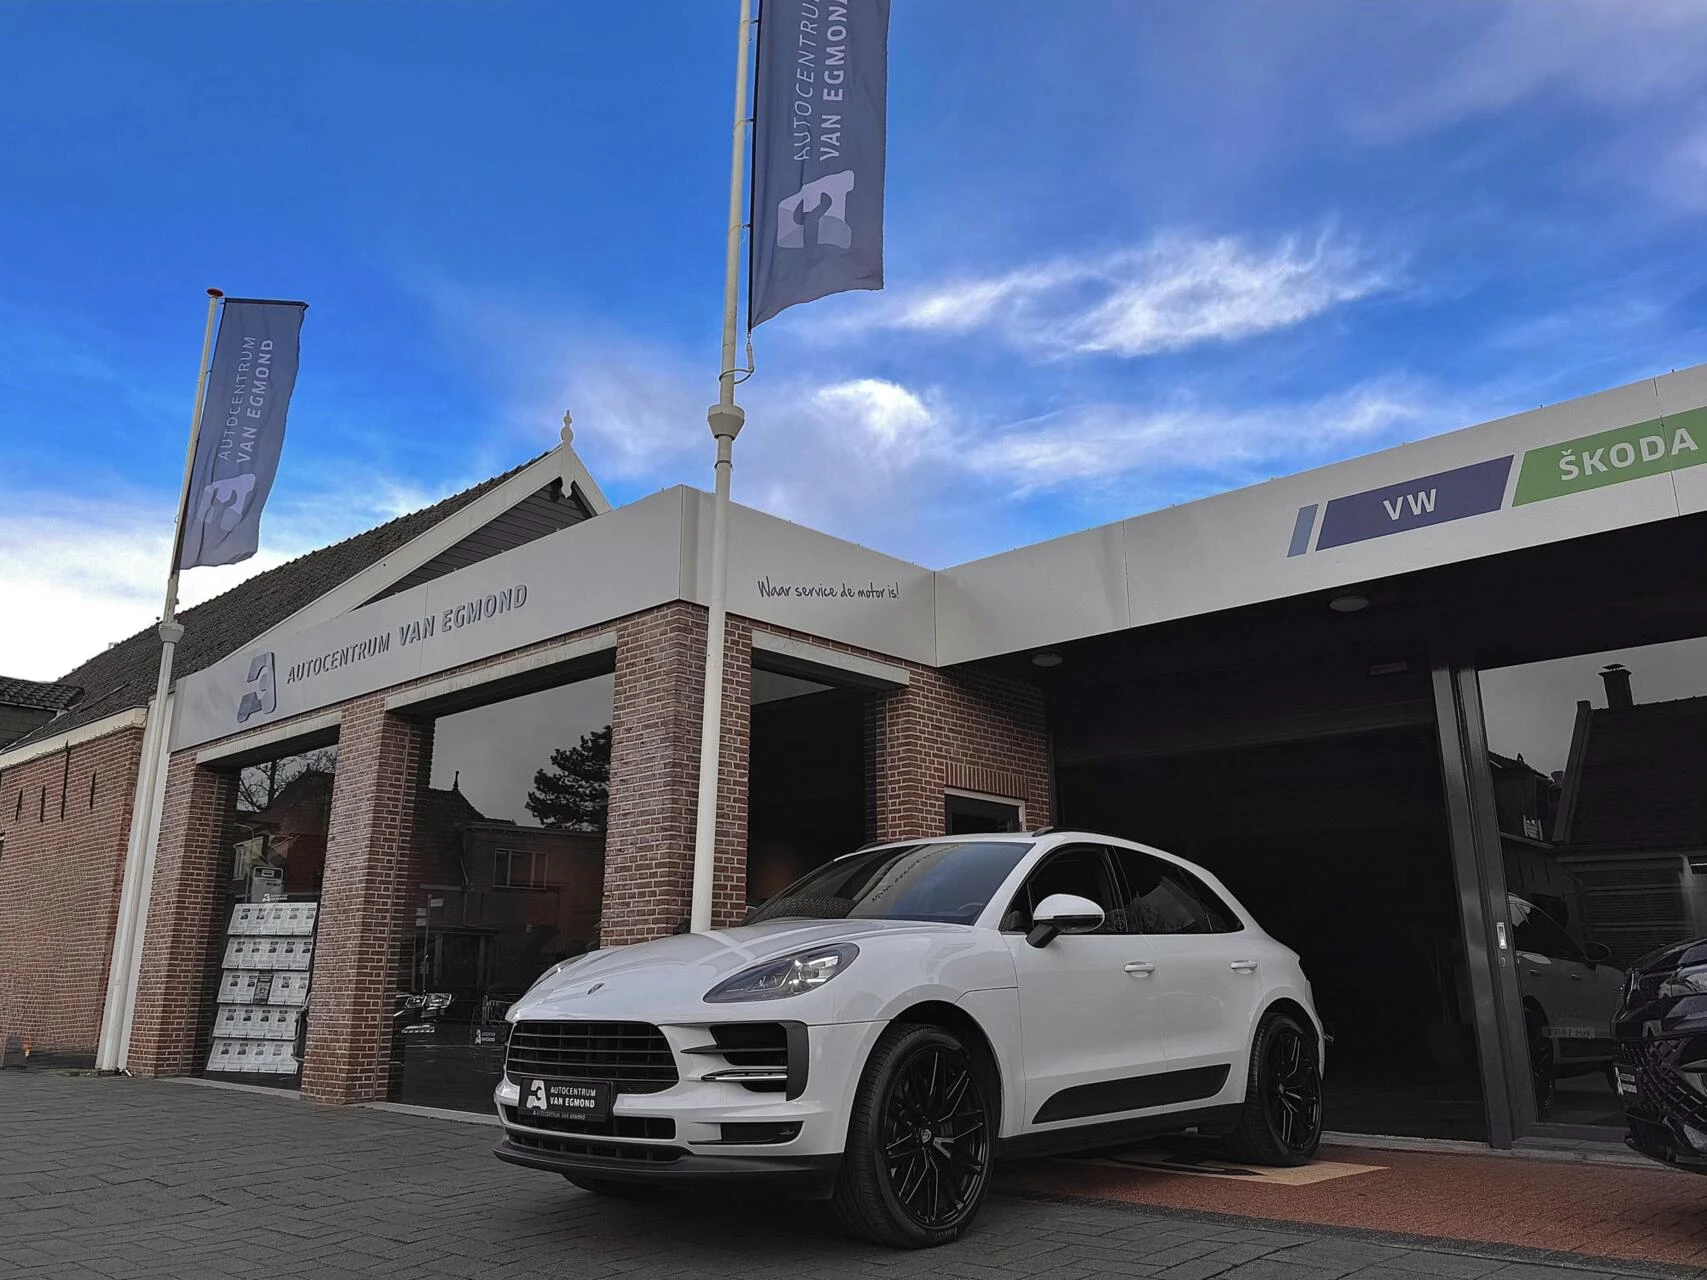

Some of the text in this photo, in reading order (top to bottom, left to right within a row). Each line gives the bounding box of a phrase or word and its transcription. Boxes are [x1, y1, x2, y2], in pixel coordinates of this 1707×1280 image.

[794, 0, 820, 161] AUTOCENTRU
[819, 0, 848, 161] VAN EGMON
[217, 336, 256, 461] AUTOCENTRUM
[236, 339, 273, 463] VAN EGMOND
[1559, 427, 1699, 481] ŠKODA
[1382, 488, 1437, 521] VW
[757, 576, 900, 599] Waar service de motor is!
[287, 584, 528, 684] AUTOCENTRUM VAN EGMOND
[549, 1096, 595, 1108] VAN EGMOND
[550, 1086, 596, 1097] AUTOCENTRUM
